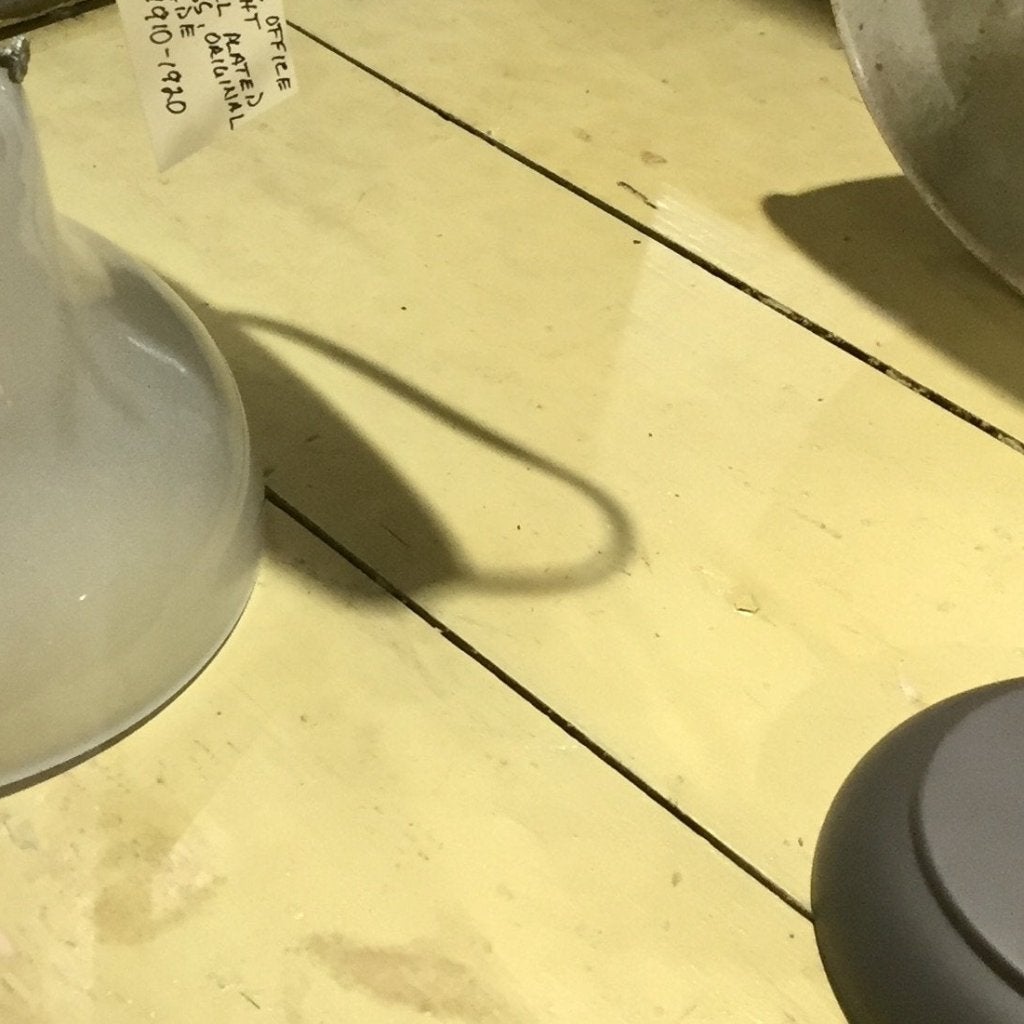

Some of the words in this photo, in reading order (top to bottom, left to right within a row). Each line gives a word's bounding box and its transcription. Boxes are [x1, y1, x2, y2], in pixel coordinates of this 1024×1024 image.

[204, 32, 245, 131] ORIGINAL
[222, 32, 264, 107] PLATED
[265, 15, 291, 91] OFFICE
